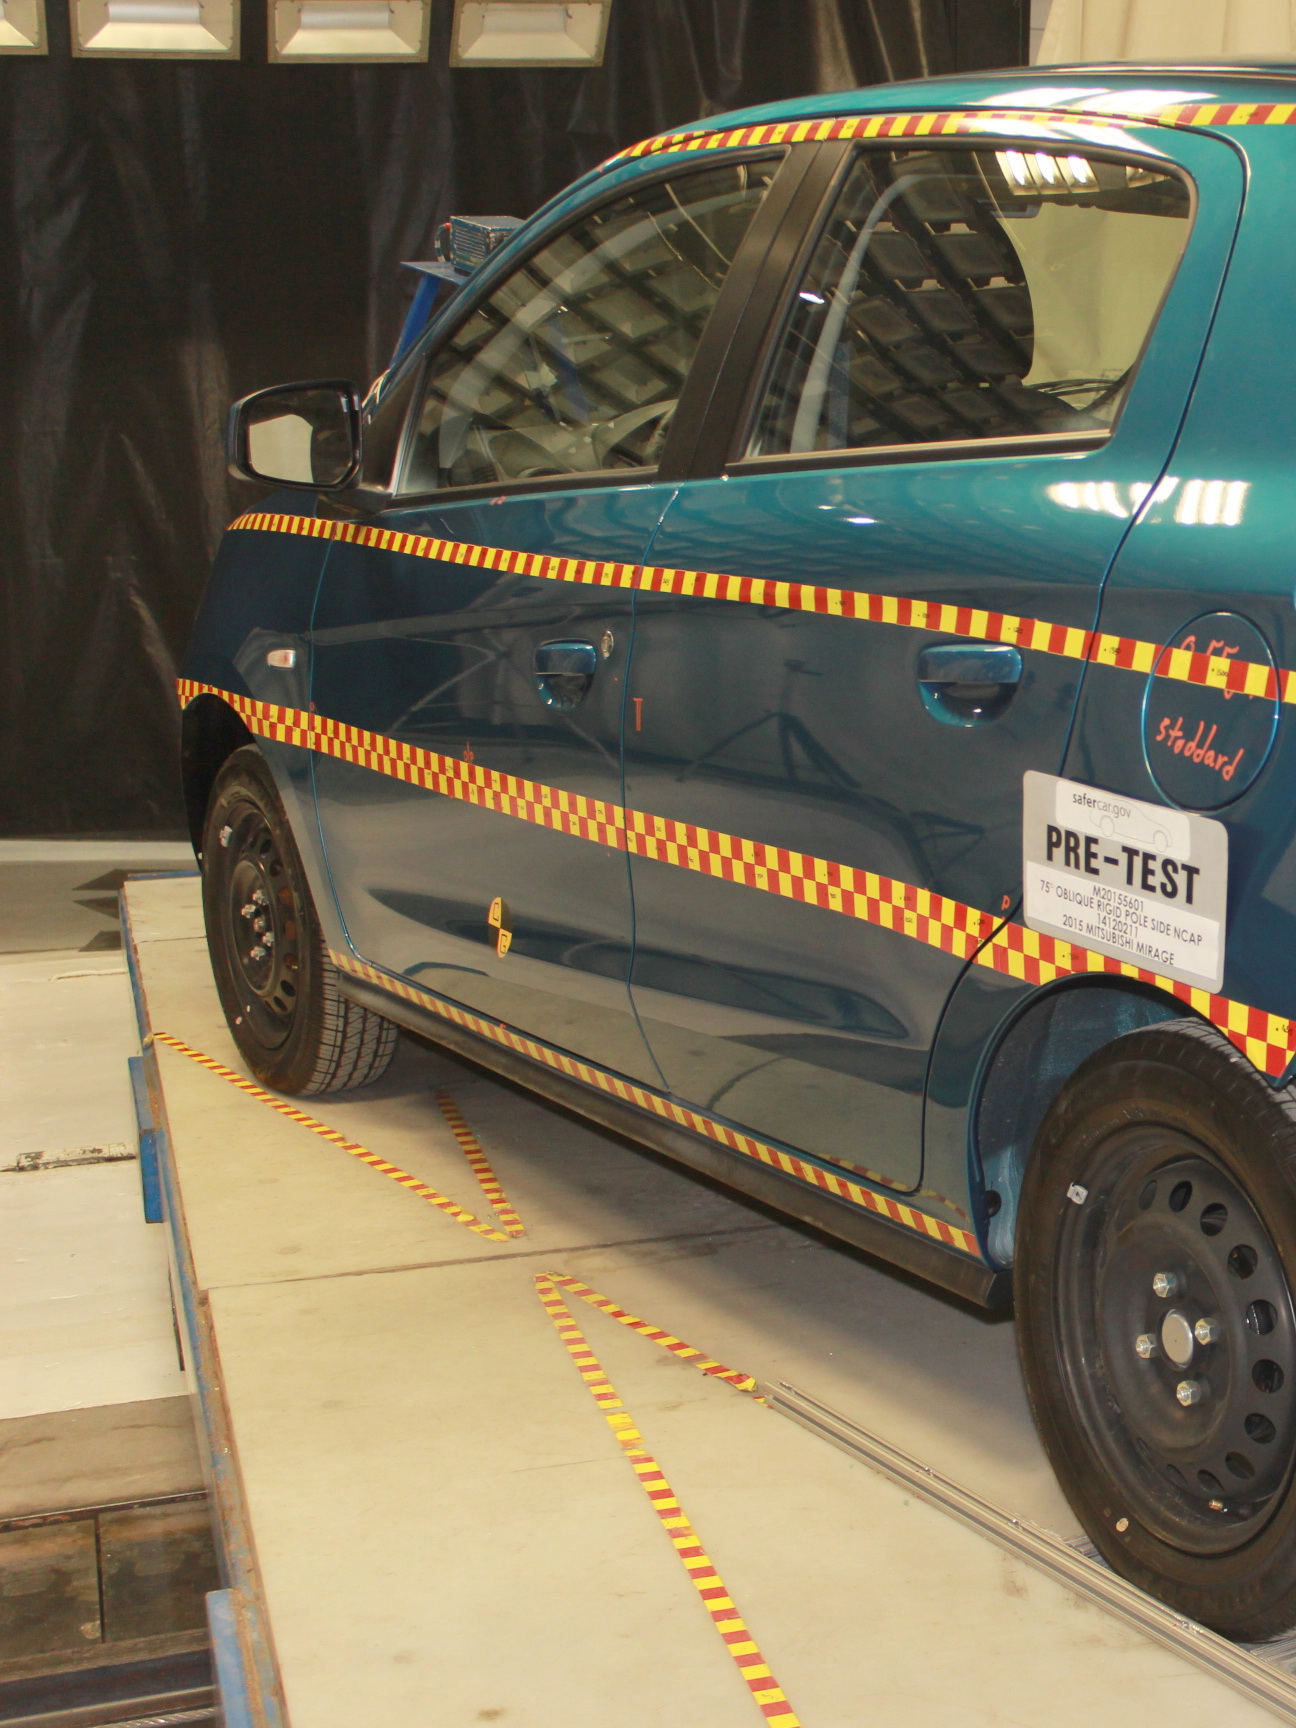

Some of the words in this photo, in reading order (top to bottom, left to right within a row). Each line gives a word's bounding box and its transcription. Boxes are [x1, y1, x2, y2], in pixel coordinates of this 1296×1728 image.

[1072, 792, 1131, 819] safercar.gov
[1046, 824, 1200, 905] PRE-TEST
[1055, 885, 1095, 909] OBLIQUE
[1097, 899, 1122, 918] RIGID
[1125, 909, 1148, 928] POLE
[1151, 918, 1171, 936] SIDE
[1173, 926, 1203, 946] NCAP
[1092, 885, 1144, 912] M20155601
[1062, 914, 1083, 932] 2015
[1086, 922, 1134, 951] MITSUBISHI
[1136, 941, 1175, 966] MIRAGE
[1097, 913, 1138, 938] 14120211
